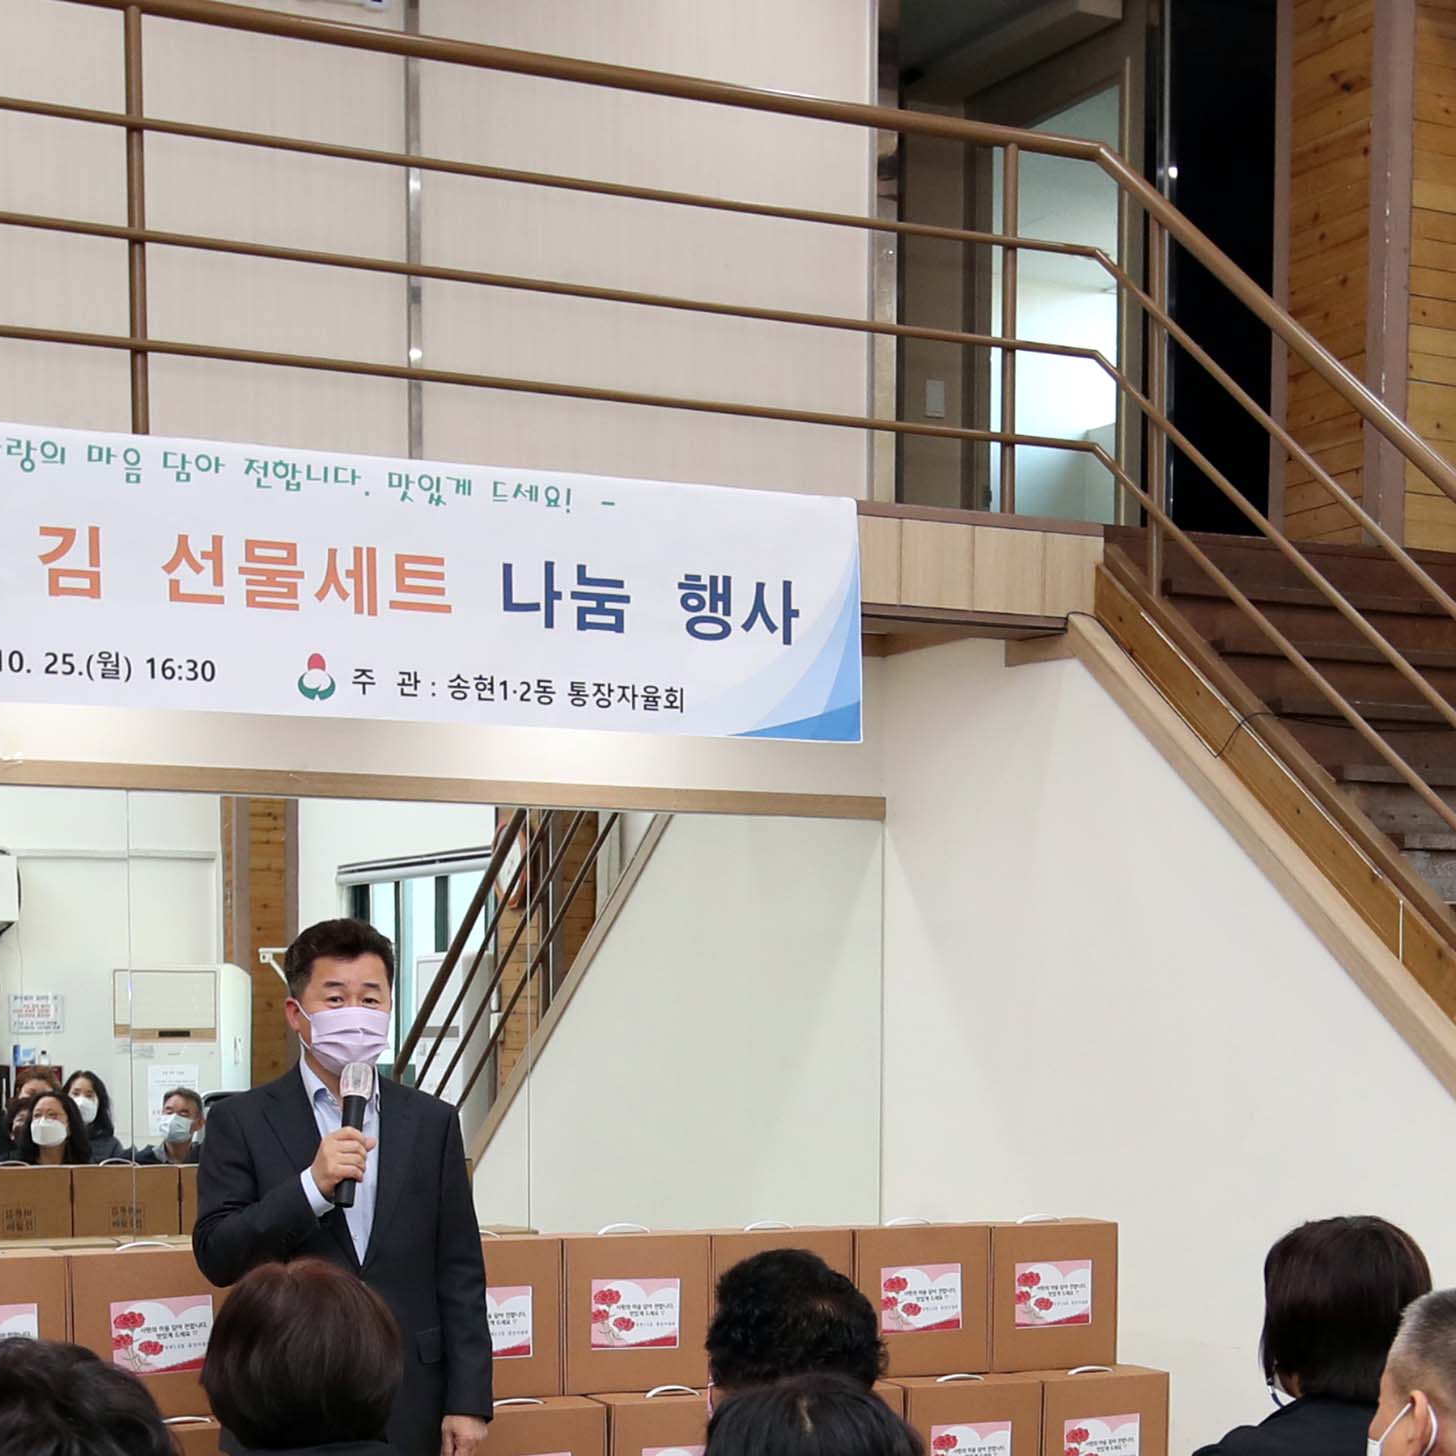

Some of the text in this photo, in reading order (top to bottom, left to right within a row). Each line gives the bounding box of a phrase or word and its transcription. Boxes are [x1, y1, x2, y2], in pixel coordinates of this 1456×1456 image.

[87, 445, 142, 484] 마음
[163, 451, 225, 482] 담아
[244, 456, 371, 497] 전합니다.
[388, 472, 472, 507] 맛있게
[493, 480, 571, 514] 드세요!
[38, 526, 101, 599] 김
[161, 534, 452, 616] 선물세트
[502, 560, 631, 634] 나눔
[677, 573, 800, 646] 행사
[44, 651, 132, 683] 25.(월)
[146, 657, 216, 682] 16:30
[567, 681, 684, 714] 통장자율회
